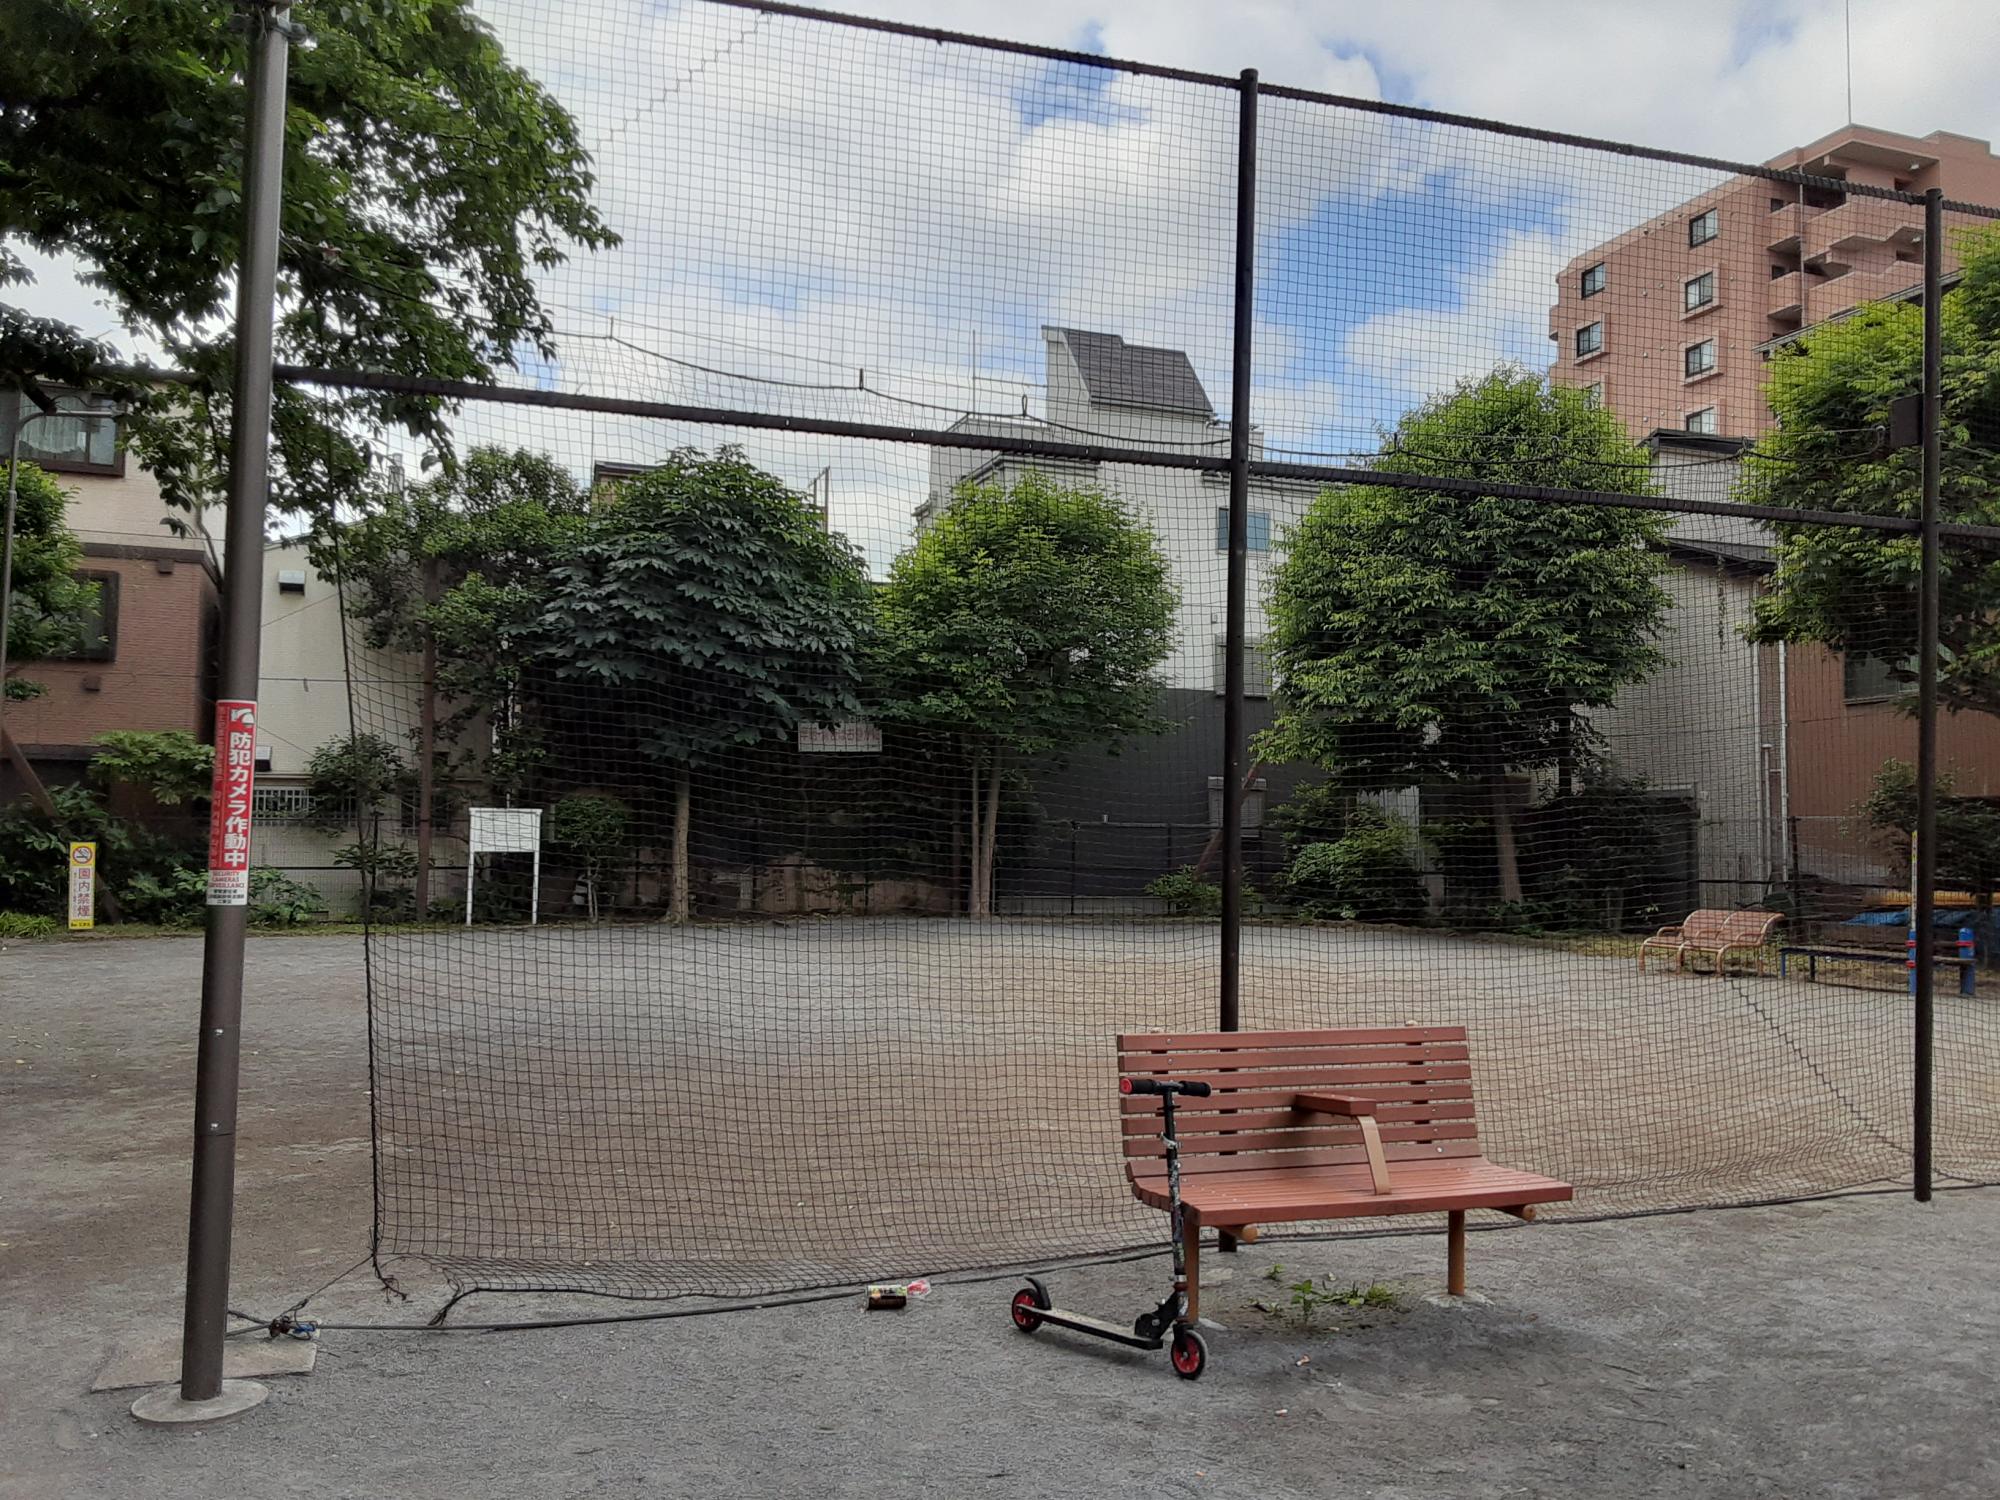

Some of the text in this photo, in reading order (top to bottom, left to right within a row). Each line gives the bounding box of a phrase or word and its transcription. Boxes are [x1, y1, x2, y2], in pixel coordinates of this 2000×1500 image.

[224, 732, 251, 867] 防犯カメラ作動中
